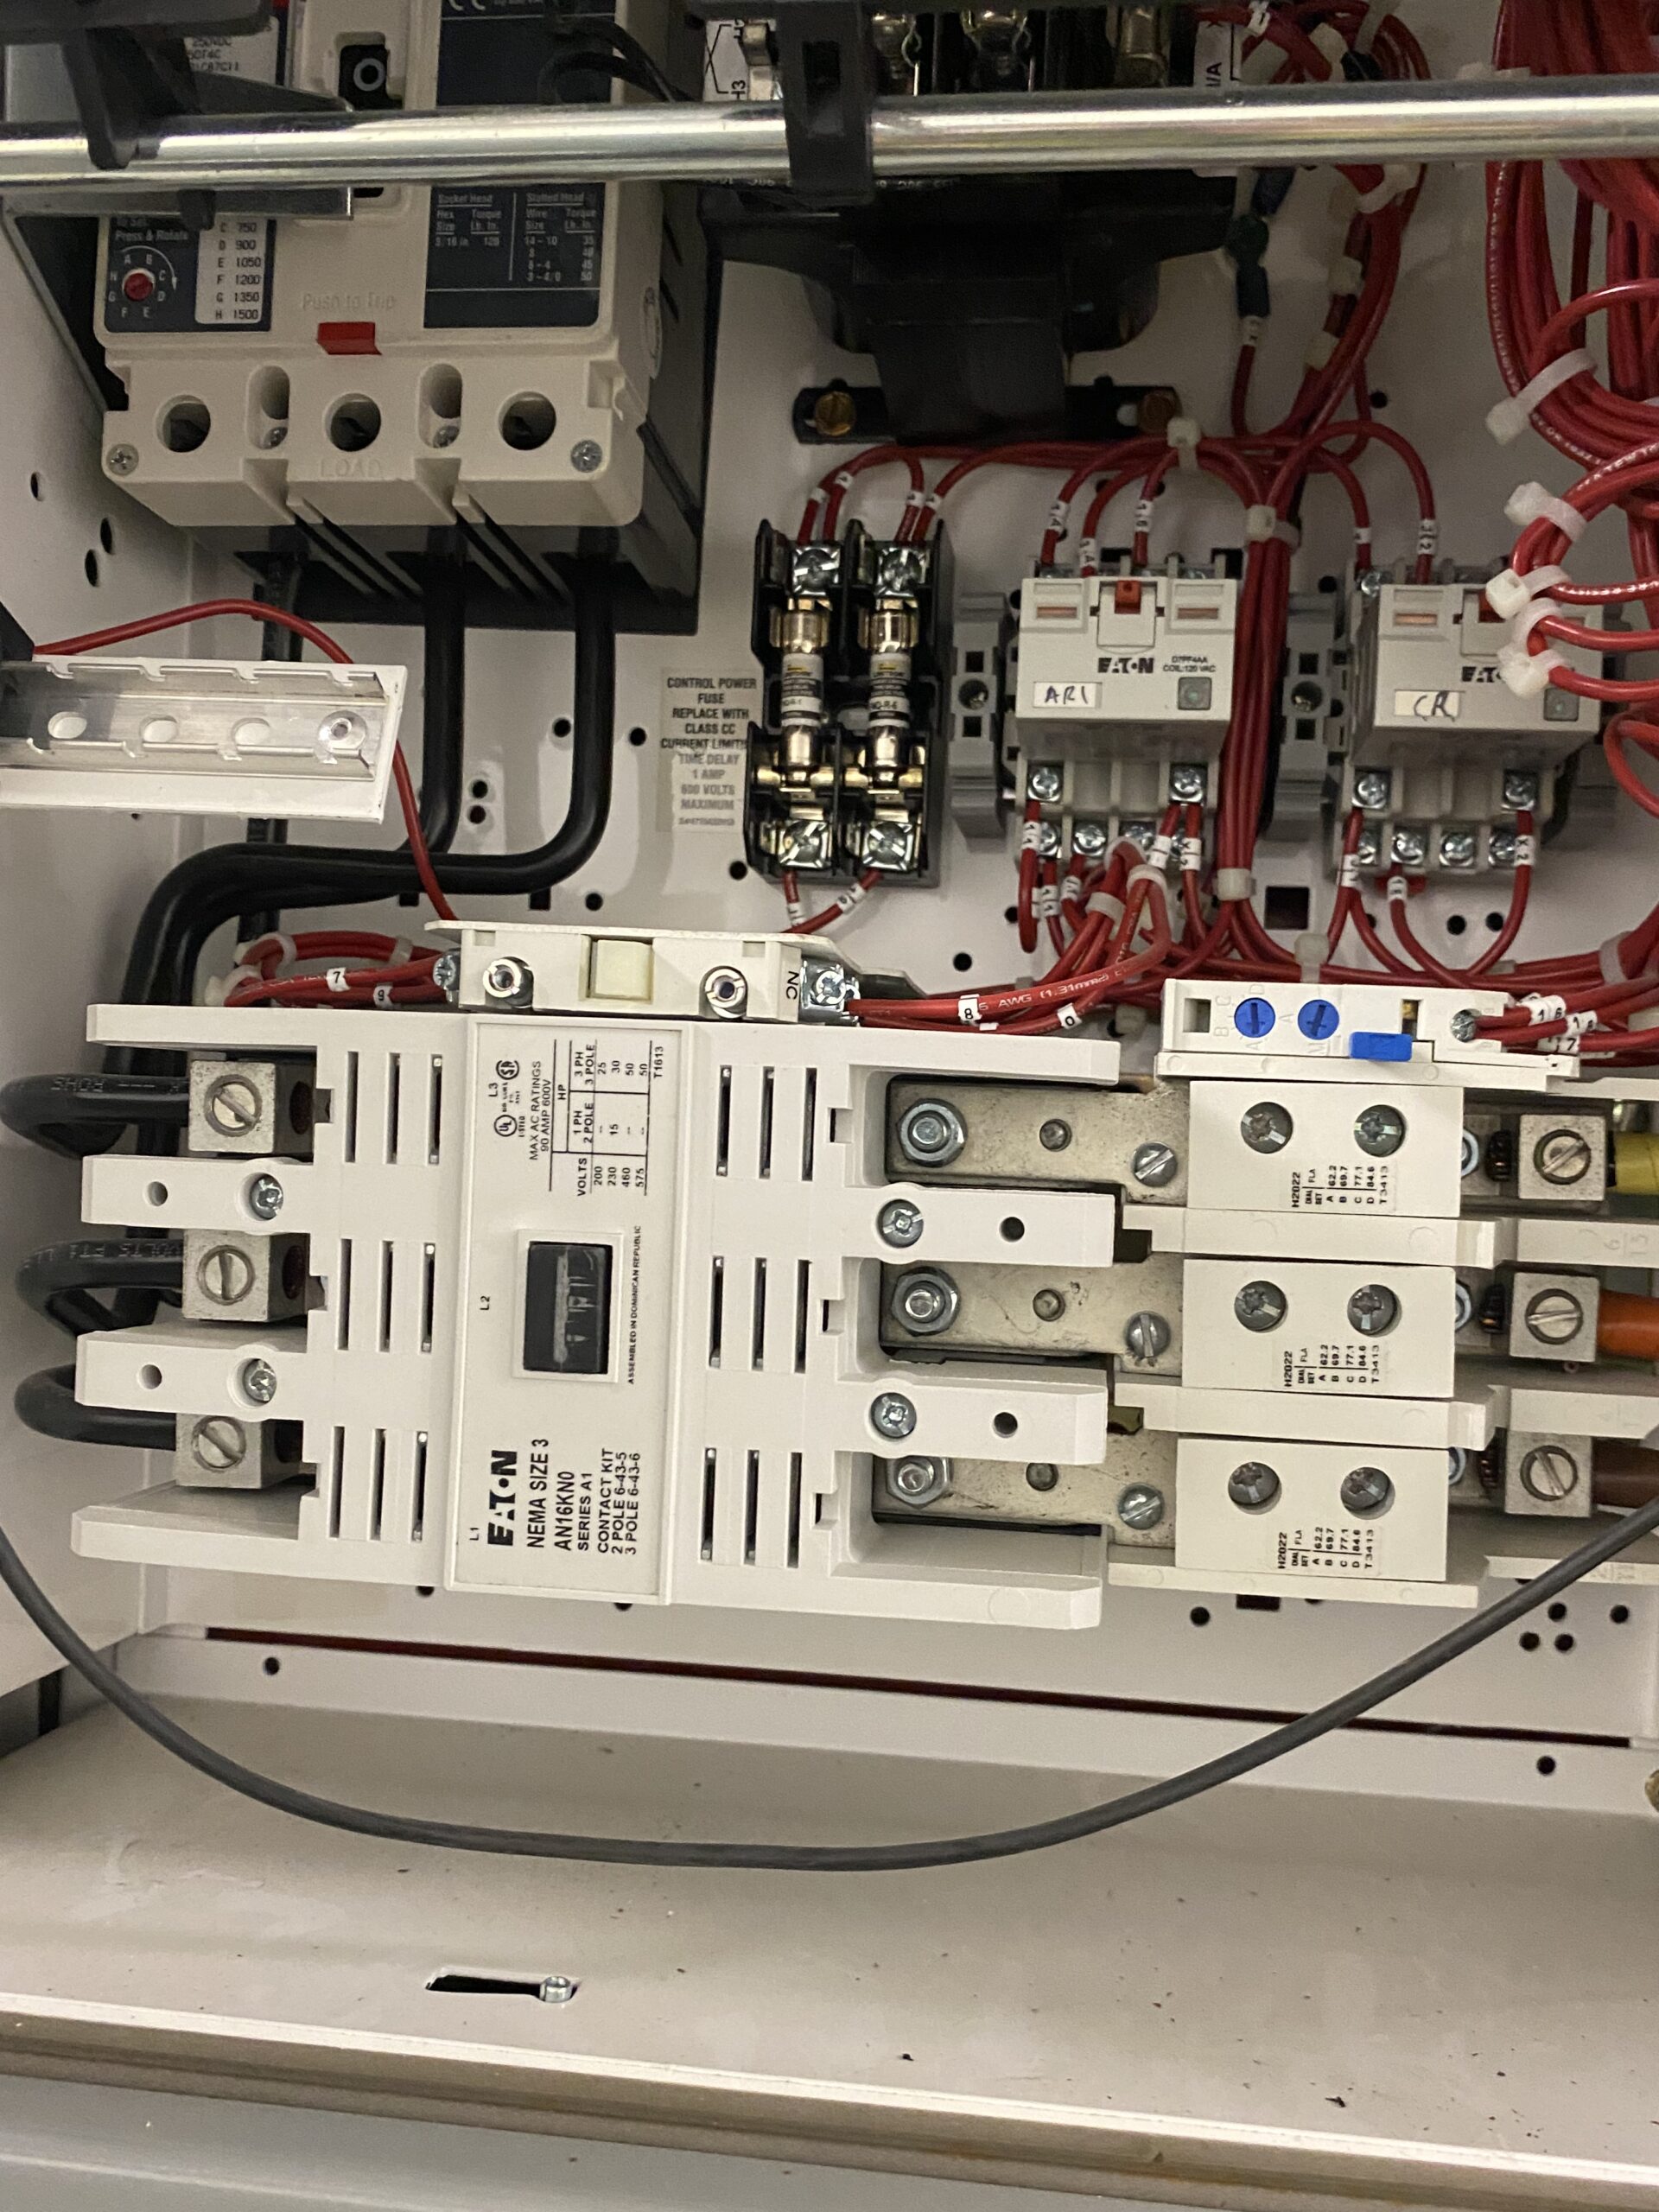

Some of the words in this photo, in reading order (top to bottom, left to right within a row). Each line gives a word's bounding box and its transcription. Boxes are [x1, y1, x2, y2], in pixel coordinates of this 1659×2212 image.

[219, 240, 226, 251] D
[235, 239, 257, 251] 900
[219, 257, 225, 268] E
[236, 257, 262, 268] 1050
[159, 270, 167, 281] C
[218, 275, 225, 284] F
[235, 274, 261, 285] 1200
[157, 291, 167, 302] D
[234, 292, 260, 302] 1350
[121, 307, 128, 318] F
[143, 307, 151, 318] E
[216, 310, 223, 320] H
[233, 309, 259, 320] 1500
[320, 458, 382, 478] LOAD
[1097, 657, 1154, 674] EATON
[667, 677, 715, 689] CONTROL
[719, 678, 757, 690] POWER
[697, 693, 725, 704] FUSE
[1414, 691, 1455, 722] CR
[672, 708, 718, 719] REPLACE
[722, 709, 749, 719] WITH
[684, 723, 718, 734] CLASS
[721, 723, 736, 734] CC
[661, 738, 709, 749] CURRENT
[679, 753, 704, 765] TIME
[707, 753, 740, 765] DELAY
[693, 769, 698, 779] 1
[701, 769, 726, 779] AMP
[703, 785, 734, 795] VOLTS
[681, 799, 734, 810] MAXIMUM
[333, 970, 341, 984] 7
[785, 970, 800, 1000] NC
[998, 994, 1033, 1008] AWG
[964, 1007, 974, 1020] 8
[575, 1051, 584, 1069] PH
[586, 1044, 596, 1076] POLE
[597, 1062, 607, 1075] 25
[611, 1060, 620, 1073] 30
[625, 1062, 634, 1077] 50
[639, 1063, 648, 1076] 50
[654, 1046, 664, 1078] T1613
[488, 1083, 499, 1097] L3
[531, 1060, 541, 1113] RATINGS
[542, 1079, 551, 1108] 600V
[557, 1084, 567, 1101] HP
[531, 1114, 540, 1137] AC
[541, 1109, 550, 1136] AMP
[574, 1110, 582, 1128] PH
[584, 1102, 594, 1134] POLE
[610, 1123, 619, 1135] 15
[530, 1137, 539, 1160] MAX
[540, 1137, 550, 1152] 90
[577, 1157, 588, 1197] VOLTS
[594, 1166, 603, 1185] 200
[607, 1166, 617, 1186] 230
[621, 1167, 631, 1187] 460
[635, 1167, 645, 1188] 575
[1328, 1165, 1337, 1186] 62.2
[1339, 1166, 1348, 1187] 69.7
[1354, 1166, 1363, 1186] 77.1
[1366, 1166, 1375, 1188] 84.6
[1291, 1172, 1300, 1208] H2022
[632, 1225, 642, 1268] REPUBLIC
[480, 1295, 491, 1311] L2
[631, 1269, 639, 1319] DOMINICAN
[631, 1319, 637, 1329] IN
[627, 1330, 637, 1385] ASSEMBLED
[1358, 1345, 1367, 1367] 84.6
[1284, 1351, 1293, 1388] H2022
[531, 1438, 550, 1447] 3
[601, 1447, 614, 1473] KIT
[529, 1452, 549, 1491] SIZE
[614, 1452, 627, 1495] 6-43-5
[627, 1452, 641, 1496] 6-43-6
[581, 1472, 593, 1491] A1
[487, 1450, 518, 1547] EATON
[527, 1497, 547, 1548] NEMA
[577, 1495, 592, 1551] SERIES
[597, 1478, 613, 1554] CONTACT
[612, 1500, 626, 1541] POLE
[626, 1501, 639, 1541] POLE
[469, 1527, 480, 1541] L1
[1314, 1527, 1323, 1549] 62.2
[1325, 1528, 1334, 1550] 69.7
[1339, 1529, 1349, 1550] 77.1
[1352, 1529, 1361, 1552] 84.6
[611, 1545, 623, 1554] 2
[625, 1547, 637, 1555] 3
[1277, 1532, 1287, 1570] H2022
